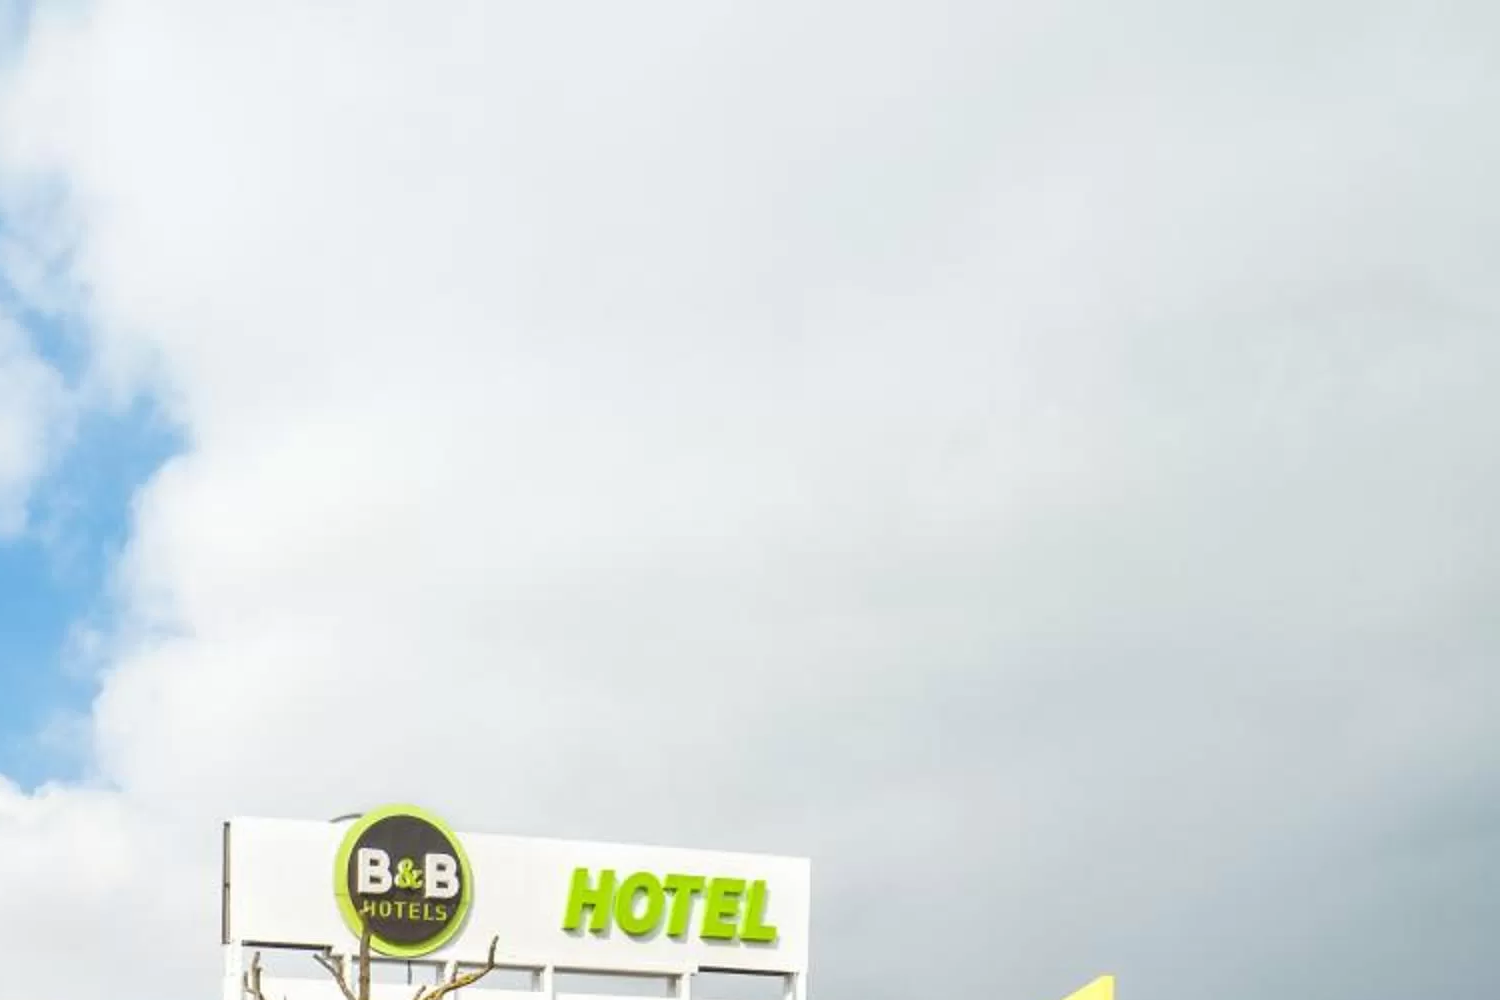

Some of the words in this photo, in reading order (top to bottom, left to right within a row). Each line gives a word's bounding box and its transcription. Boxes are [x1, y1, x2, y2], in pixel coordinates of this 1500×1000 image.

[357, 847, 460, 899] B&B
[361, 899, 448, 921] HOTELS
[561, 867, 778, 944] HOTEL
